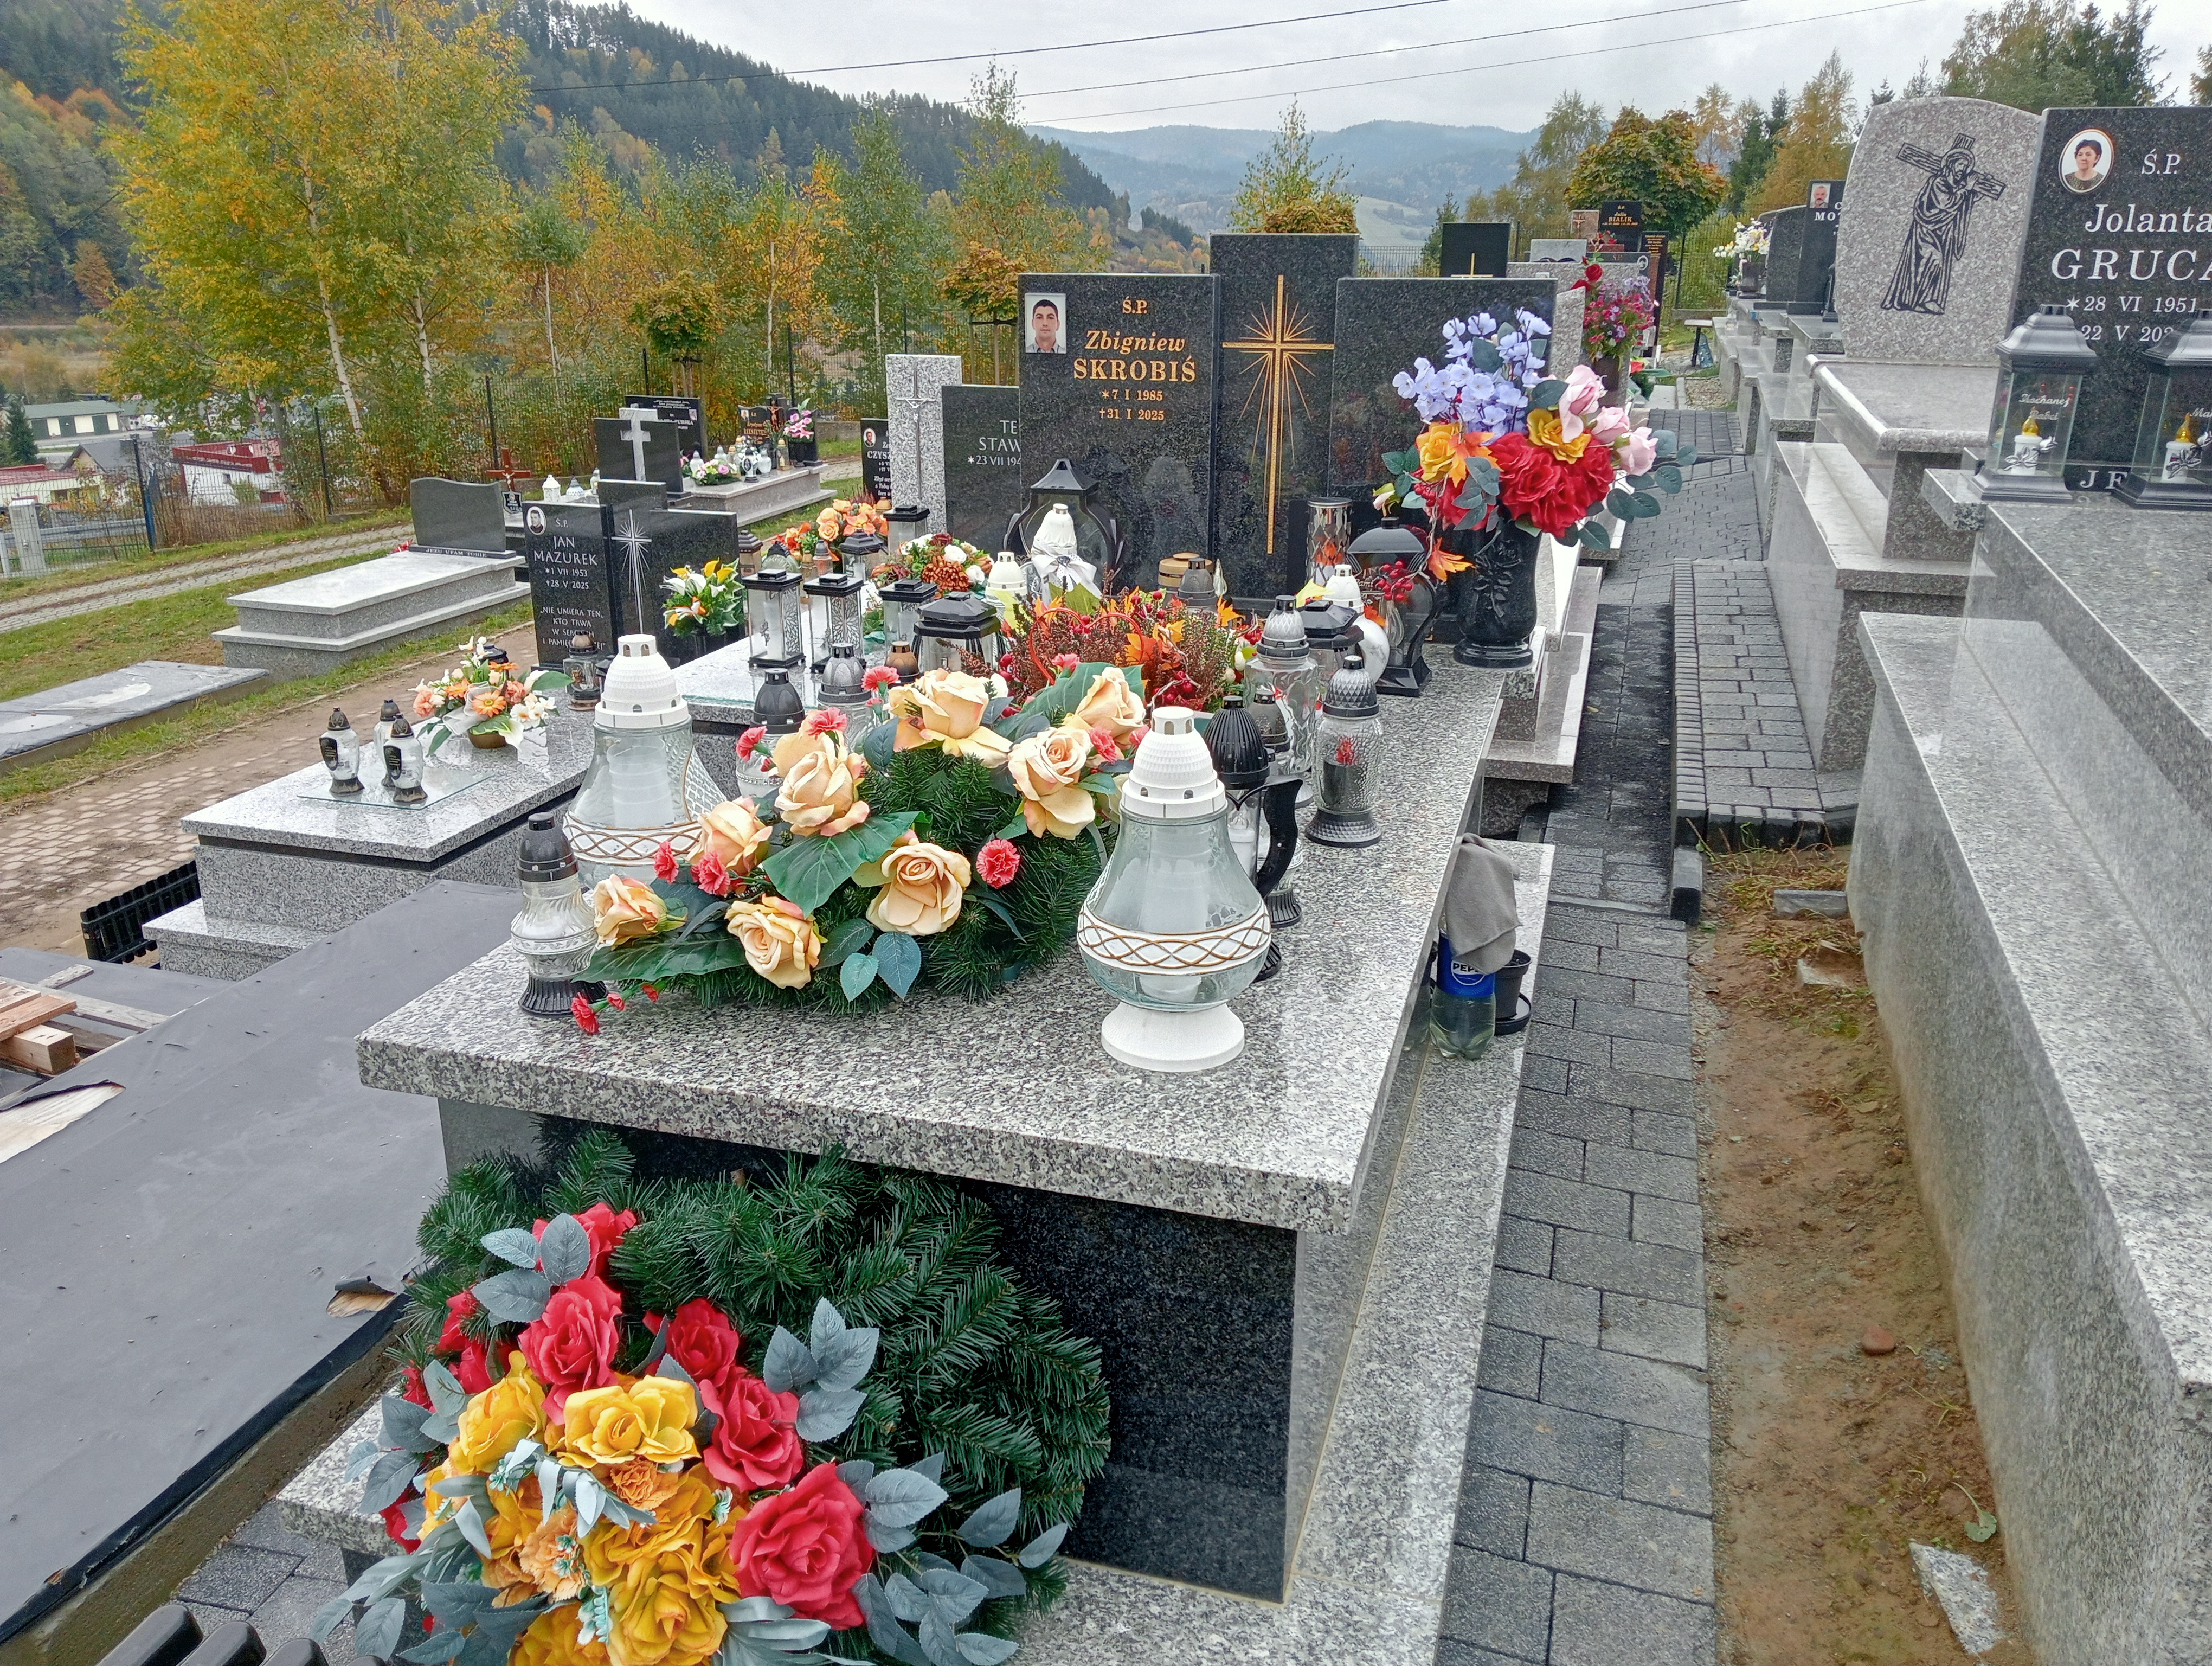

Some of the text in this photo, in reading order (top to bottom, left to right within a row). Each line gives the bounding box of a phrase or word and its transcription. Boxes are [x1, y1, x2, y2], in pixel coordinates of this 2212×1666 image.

[2141, 148, 2181, 175] Ś.P.
[1814, 212, 1841, 221] MO
[2085, 203, 2212, 233] Jolanta
[1122, 296, 1148, 314] Ś.P.
[2084, 296, 2197, 313] 28 VI 1951
[2114, 325, 2130, 341] V
[1084, 330, 1186, 355] Zbigniew
[1073, 355, 1196, 383] SKROBIŚ
[1124, 389, 1130, 400] I
[1137, 390, 1163, 401] 1985
[1126, 408, 1132, 420] I
[1137, 409, 1165, 421] 2025
[989, 456, 1004, 466] VII
[556, 517, 569, 528] Ś.P.
[553, 535, 575, 549] JAN
[533, 550, 597, 566] MAZUREK
[557, 567, 568, 575] VII
[572, 569, 588, 577] 1953
[562, 580, 568, 588] V
[572, 581, 589, 589] 2025
[557, 607, 584, 616] UMIERA
[587, 609, 603, 618] TEN,
[571, 619, 592, 627] TRWA
[562, 629, 594, 638] SERCH
[548, 638, 572, 648] PAMIĘC
[1453, 963, 1478, 972] PEP
